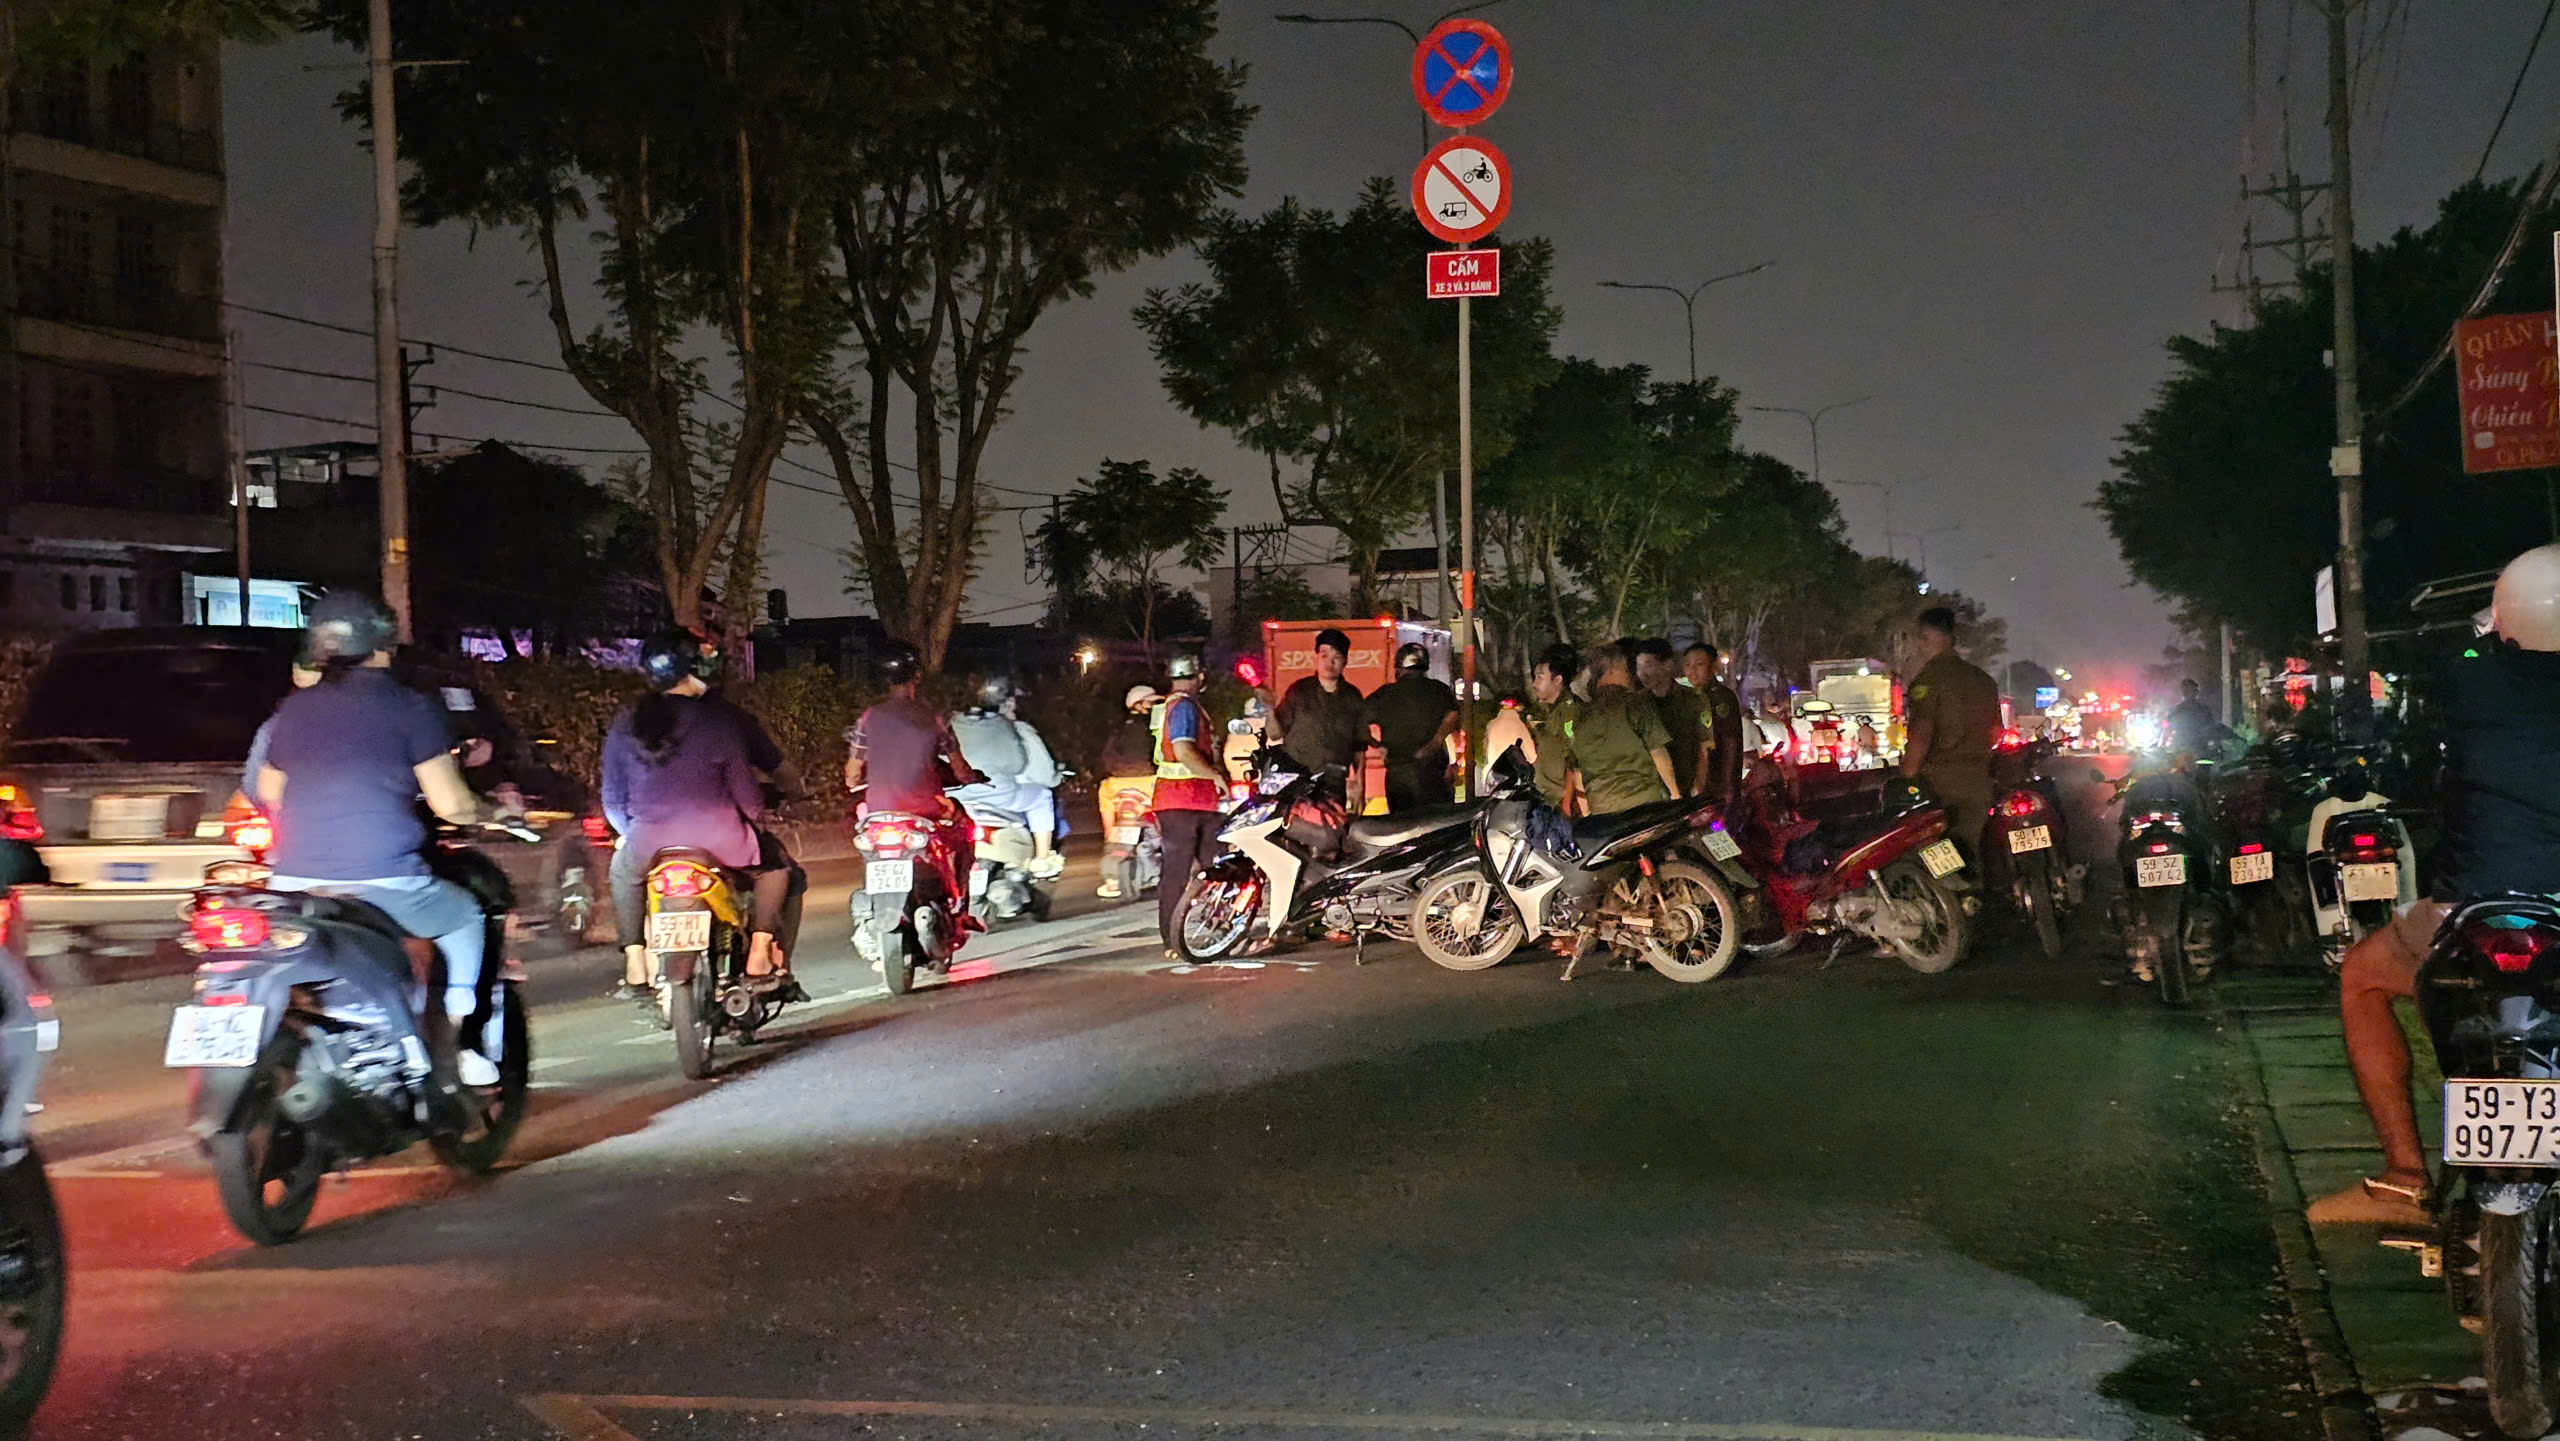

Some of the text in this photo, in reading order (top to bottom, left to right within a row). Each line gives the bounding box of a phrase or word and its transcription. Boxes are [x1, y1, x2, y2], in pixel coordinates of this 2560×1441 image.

[1448, 256, 1479, 277] CẤM
[1435, 283, 1446, 293] XE
[1447, 282, 1453, 293] 2
[1464, 282, 1470, 291] 3
[1470, 280, 1492, 291] BÁNH
[2464, 1086, 2556, 1119] 59-Y3
[2455, 1125, 2560, 1160] 997.73
